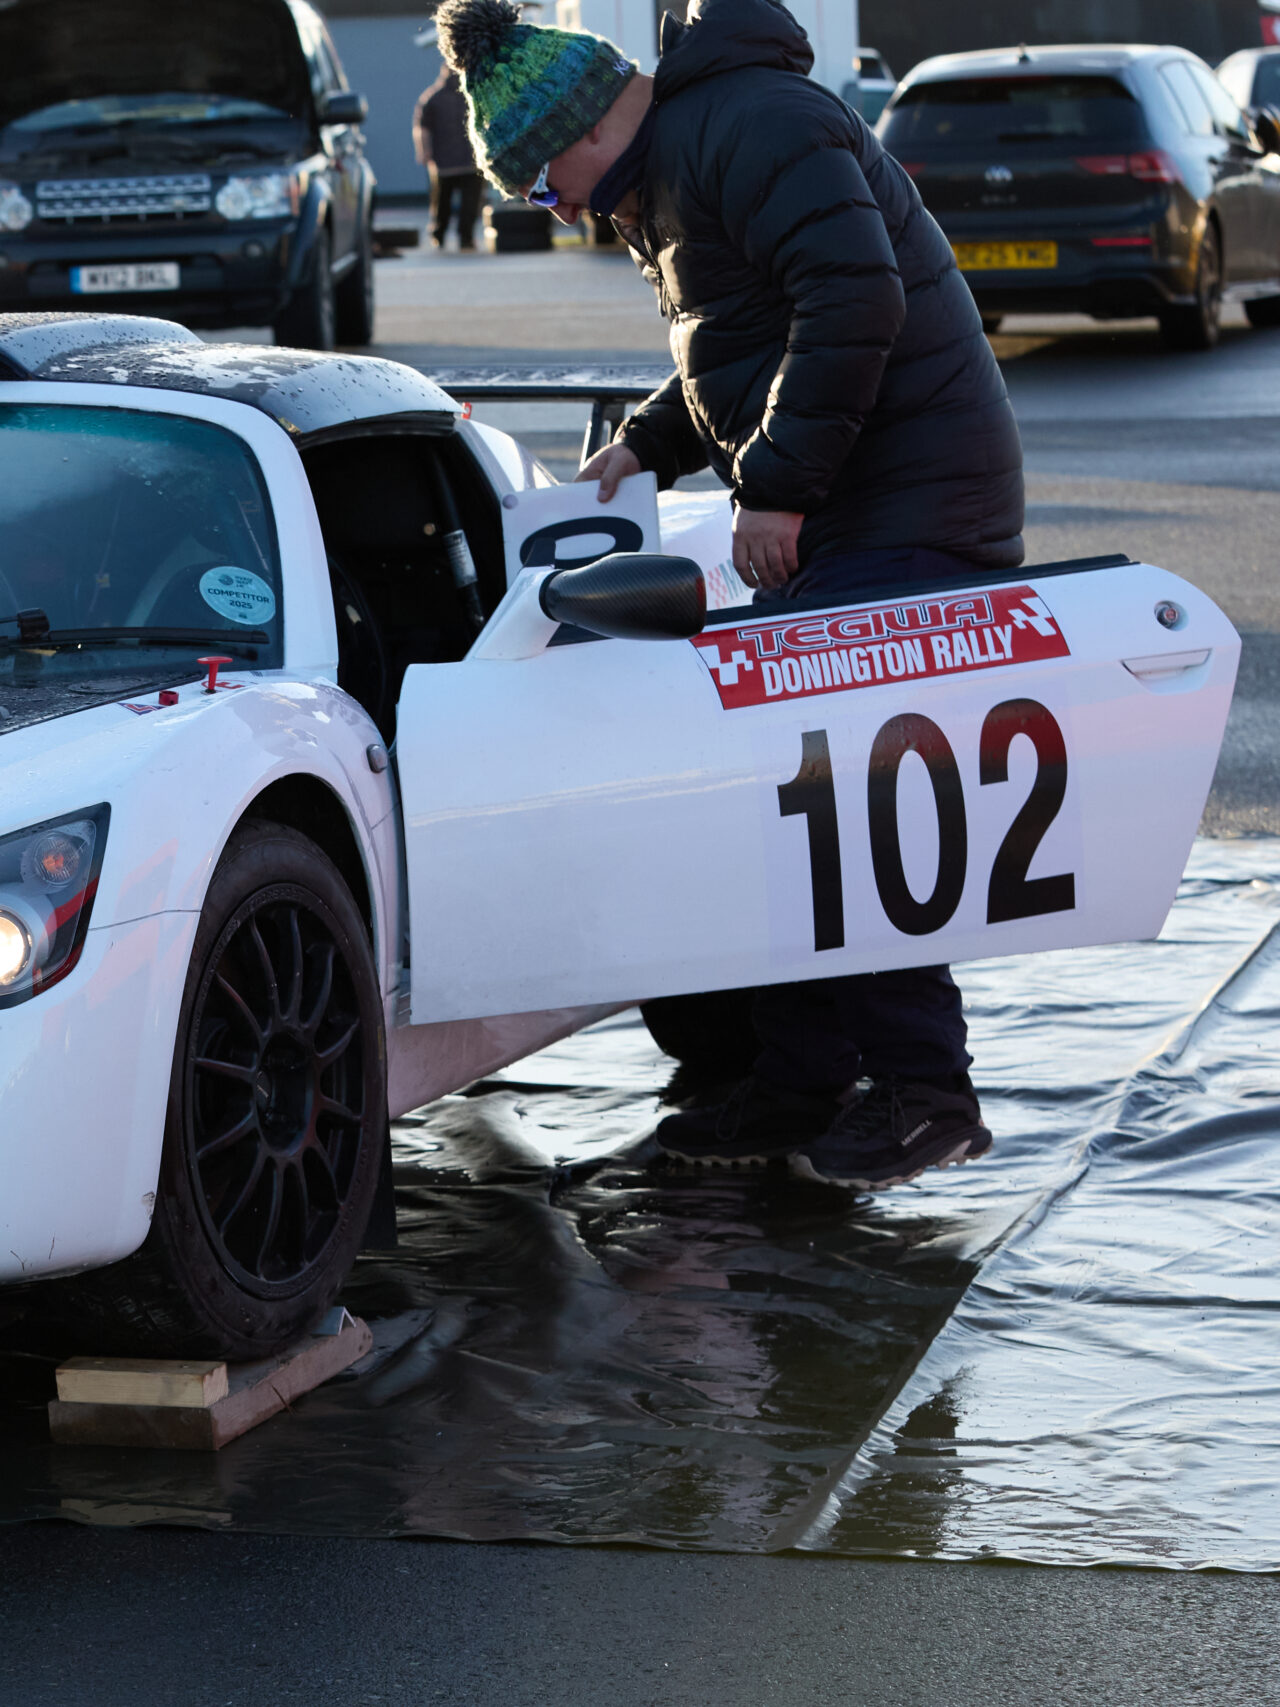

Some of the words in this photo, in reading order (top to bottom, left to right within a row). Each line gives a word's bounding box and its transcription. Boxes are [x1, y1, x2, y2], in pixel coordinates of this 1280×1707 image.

[207, 588, 270, 603] COMPETITOR
[229, 600, 253, 610] 2025
[737, 594, 994, 658] TEGIWA
[760, 637, 926, 697] DONINGTON
[930, 625, 1015, 672] RALLY
[777, 697, 1076, 952] 102
